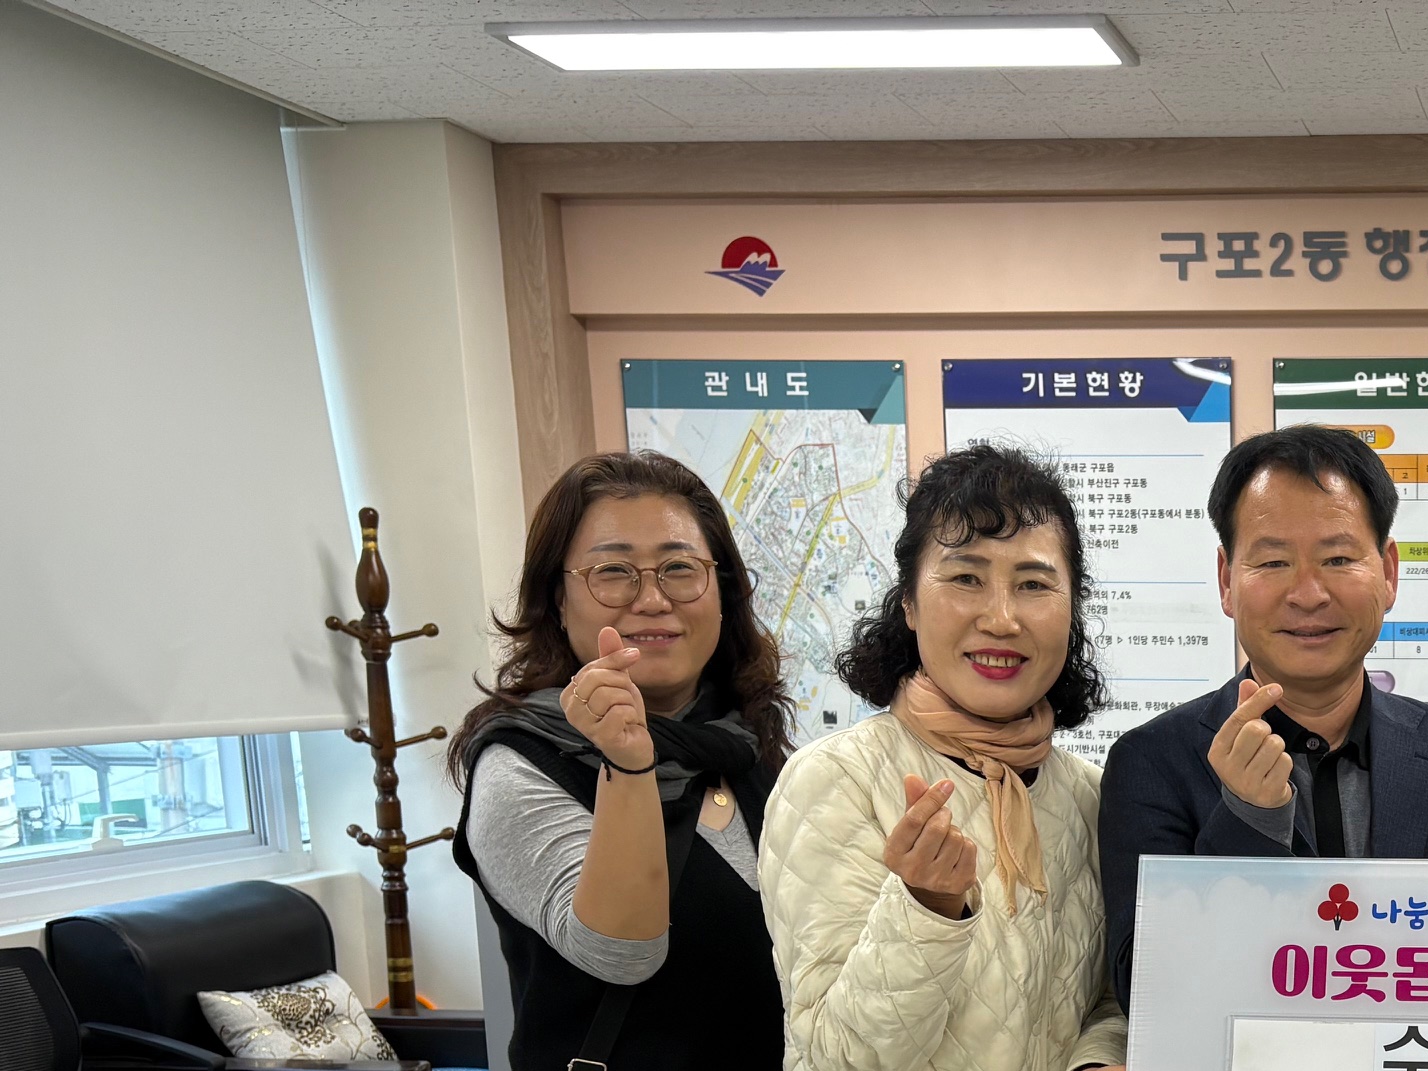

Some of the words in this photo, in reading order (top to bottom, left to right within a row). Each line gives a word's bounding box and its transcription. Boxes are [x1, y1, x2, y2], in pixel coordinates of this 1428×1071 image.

[1160, 229, 1348, 283] 구포2동
[1021, 370, 1144, 398] 기본현황
[1087, 478, 1121, 488] 부산진구
[1123, 477, 1148, 488] 구포동
[1107, 493, 1132, 504] 구포동
[1108, 524, 1138, 534] 구포2동
[1111, 591, 1132, 600] 7.4%
[1128, 635, 1148, 646] 1인당
[1151, 635, 1175, 646] 주민수
[1178, 635, 1209, 647] 1,397명
